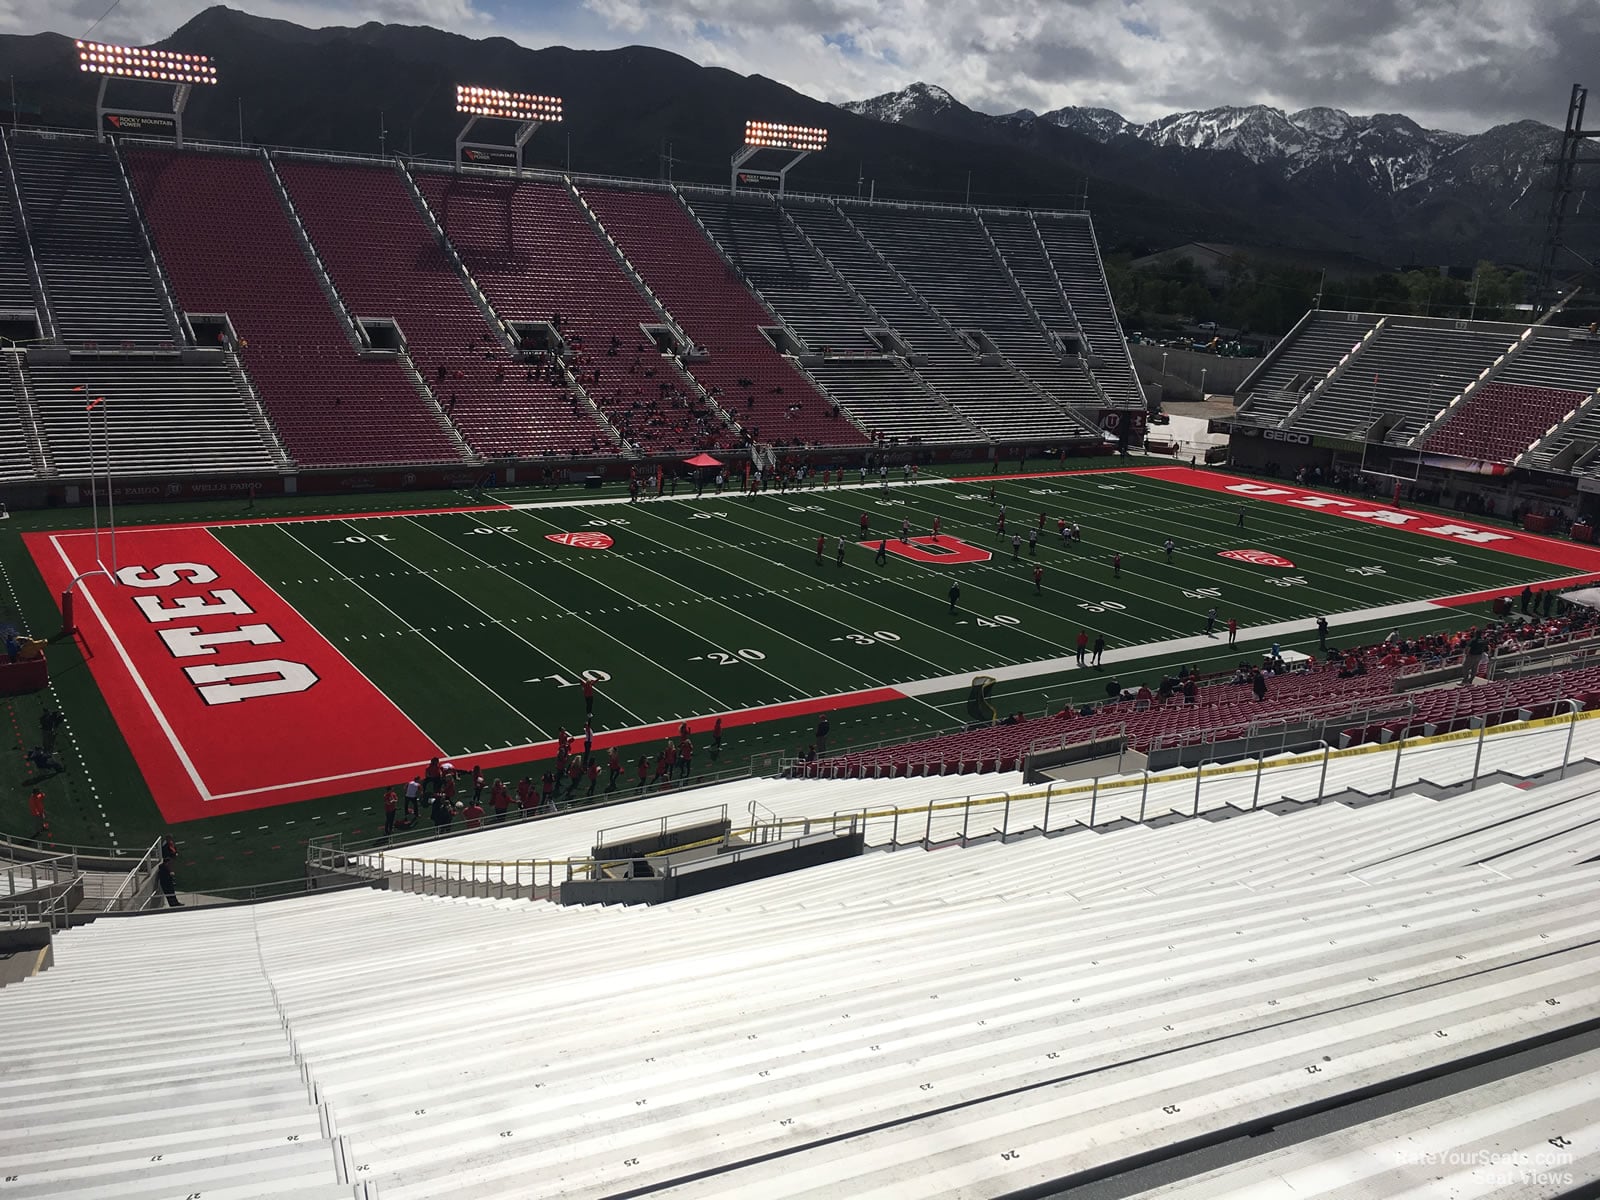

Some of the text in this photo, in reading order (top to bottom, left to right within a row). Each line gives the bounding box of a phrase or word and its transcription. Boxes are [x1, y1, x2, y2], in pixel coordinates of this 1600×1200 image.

[141, 118, 173, 126] MOUNTAIN
[1263, 430, 1310, 444] GEICO
[192, 483, 227, 491] WELLS
[692, 511, 728, 519] 40
[1225, 483, 1514, 543] UTAH
[588, 518, 631, 527] 30
[474, 525, 518, 535] 20
[345, 533, 397, 544] 10
[1182, 588, 1222, 599] 40
[1076, 600, 1127, 613] 50
[976, 614, 1021, 628] 40
[115, 561, 321, 706] UTES
[845, 630, 902, 645] 30
[707, 648, 768, 665] 20
[543, 669, 612, 688] 10
[1545, 998, 1561, 1007] 20
[1162, 1024, 1174, 1032] 21
[1434, 1030, 1448, 1039] 21
[1046, 1052, 1060, 1060] 22
[758, 1070, 770, 1078] 23
[1304, 1064, 1322, 1075] 22
[920, 1082, 934, 1091] 23
[1162, 1104, 1181, 1115] 23
[779, 1117, 795, 1127] 24
[1548, 1136, 1573, 1150] 23
[1001, 1150, 1020, 1161] 24
[356, 1163, 370, 1172] 26
[623, 1158, 640, 1168] 25
